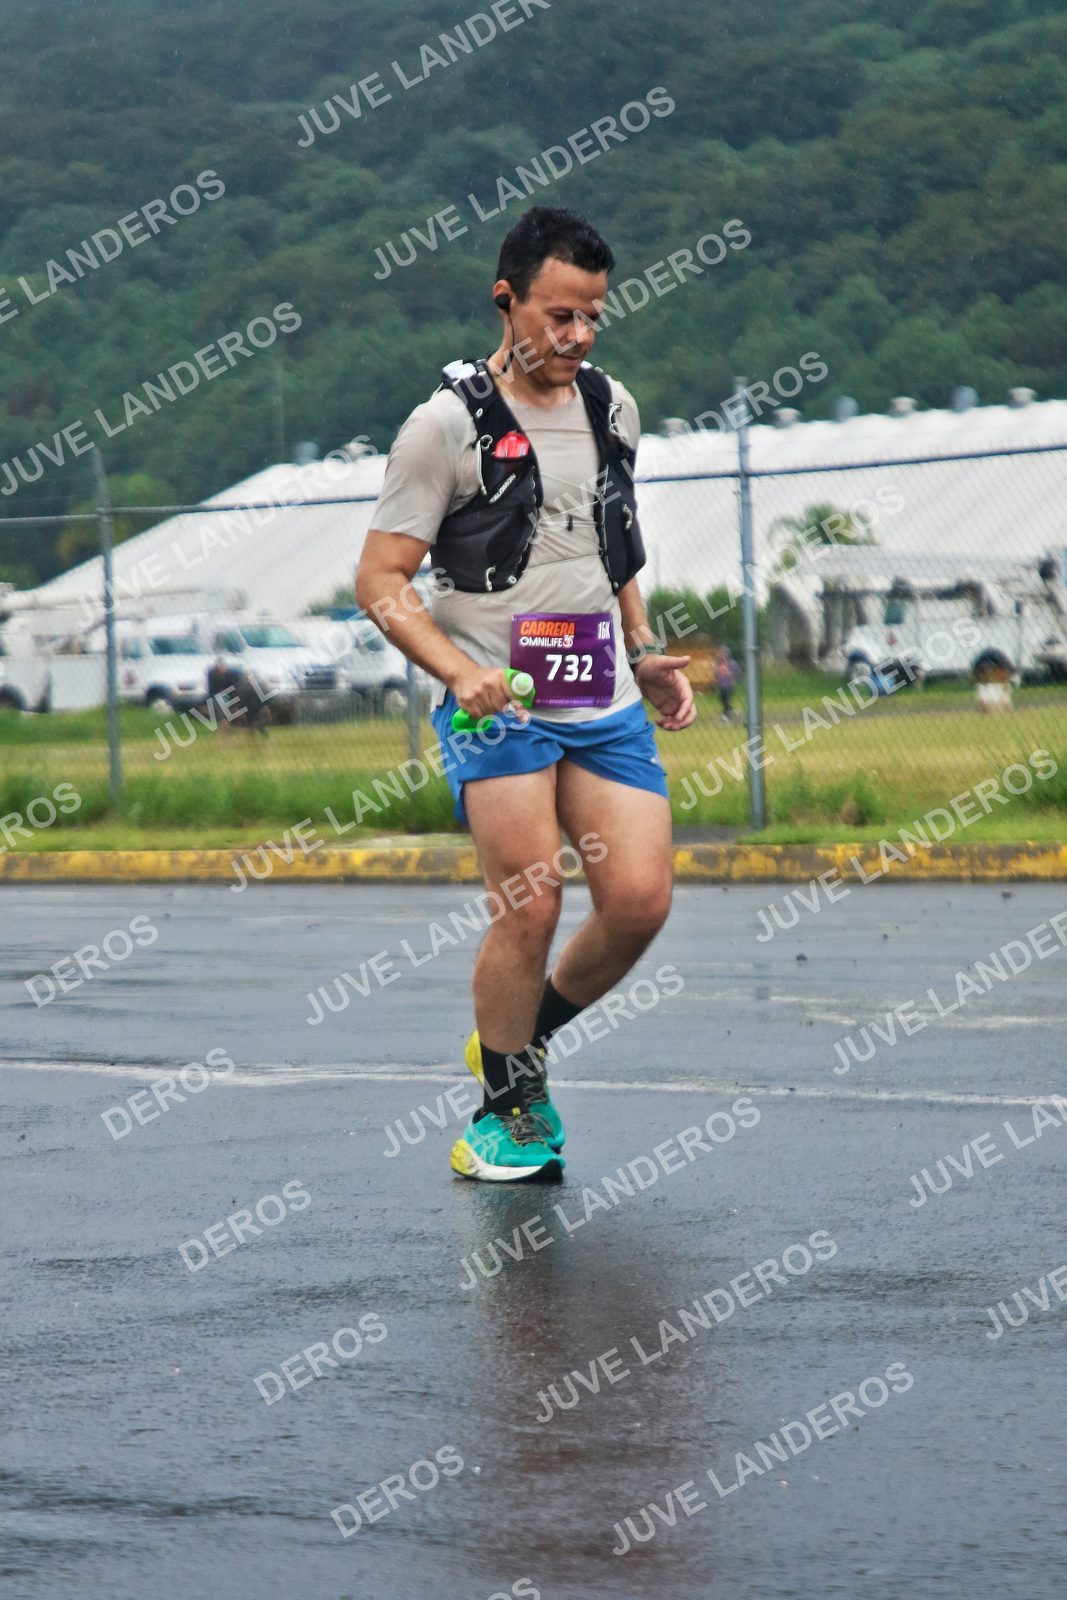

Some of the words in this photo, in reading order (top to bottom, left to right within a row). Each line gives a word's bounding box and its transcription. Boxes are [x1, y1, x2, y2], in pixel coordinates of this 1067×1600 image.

[520, 621, 576, 637] CARRERA
[598, 621, 611, 640] 16K
[545, 653, 593, 682] 732
